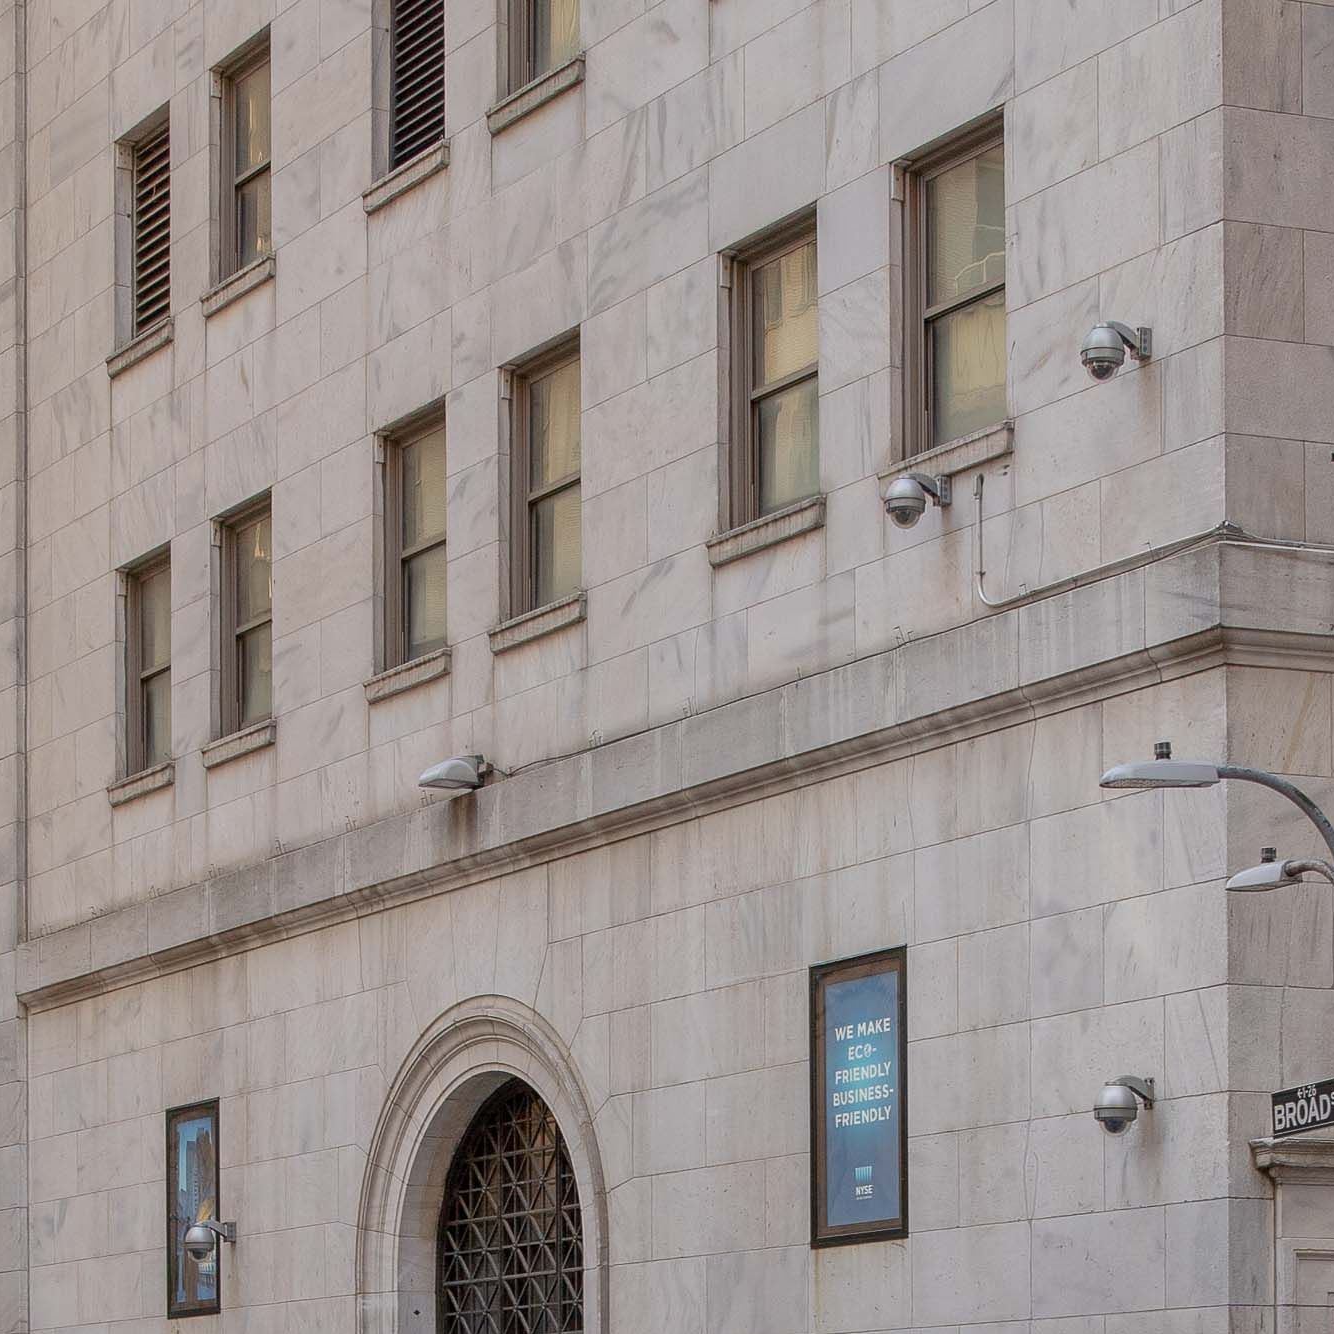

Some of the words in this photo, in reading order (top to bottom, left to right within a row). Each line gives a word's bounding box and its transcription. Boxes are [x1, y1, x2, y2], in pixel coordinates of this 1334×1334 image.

[835, 1025, 854, 1041] WE
[857, 1017, 891, 1037] MAKE
[835, 1061, 892, 1085] FRIENDLY
[833, 1083, 894, 1107] BUSINESS-
[835, 1105, 892, 1128] FRIENDLY
[1274, 1094, 1331, 1131] BROAD
[855, 1184, 874, 1196] NYSE
